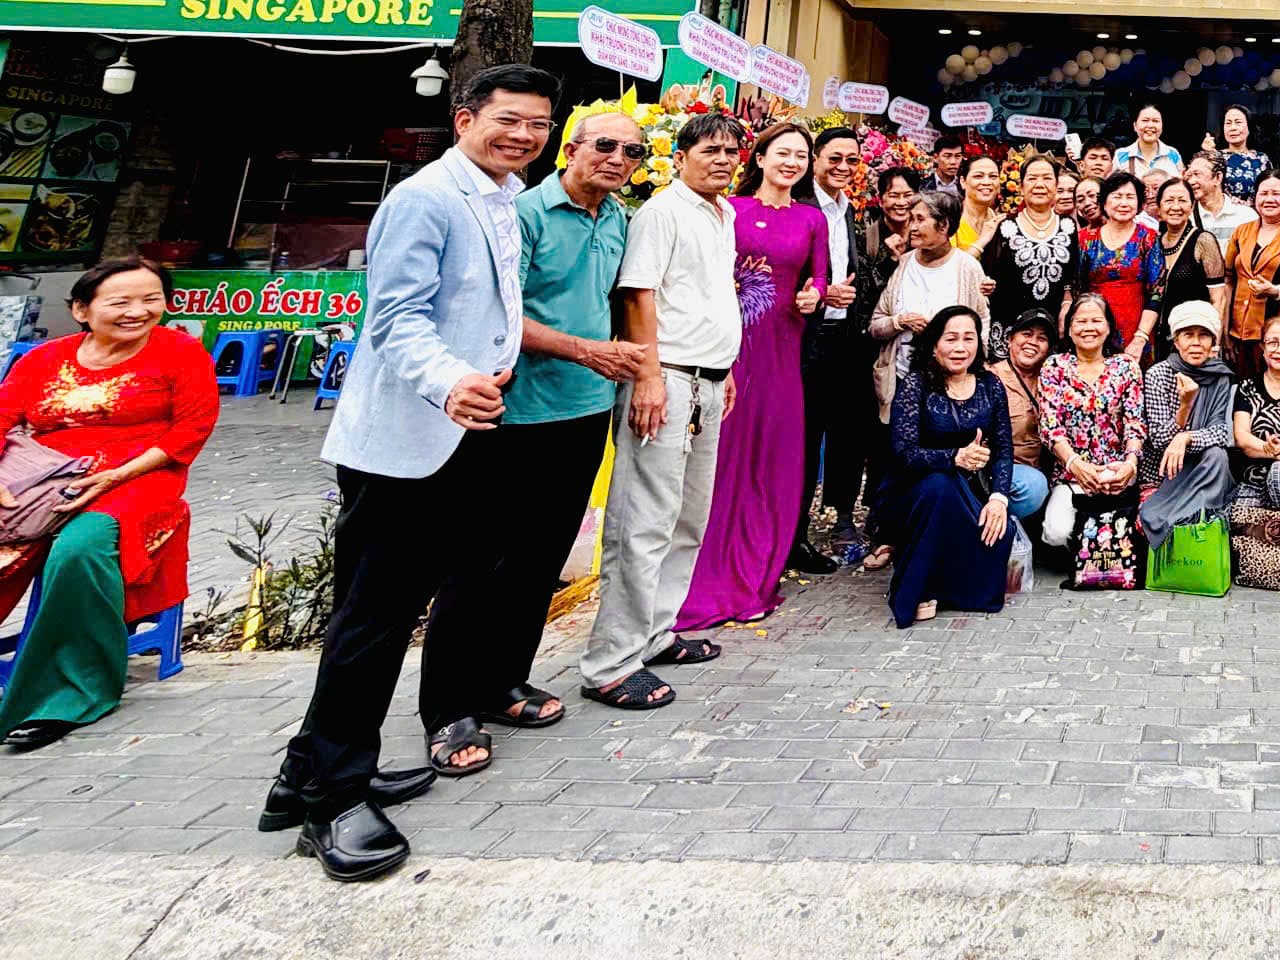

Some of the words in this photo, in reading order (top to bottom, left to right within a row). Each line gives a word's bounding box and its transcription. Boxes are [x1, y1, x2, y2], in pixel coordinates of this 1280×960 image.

[6, 85, 113, 111] SINGAPORE
[166, 282, 254, 315] CHÁO
[258, 277, 323, 316] ẾCH
[326, 291, 363, 319] 36
